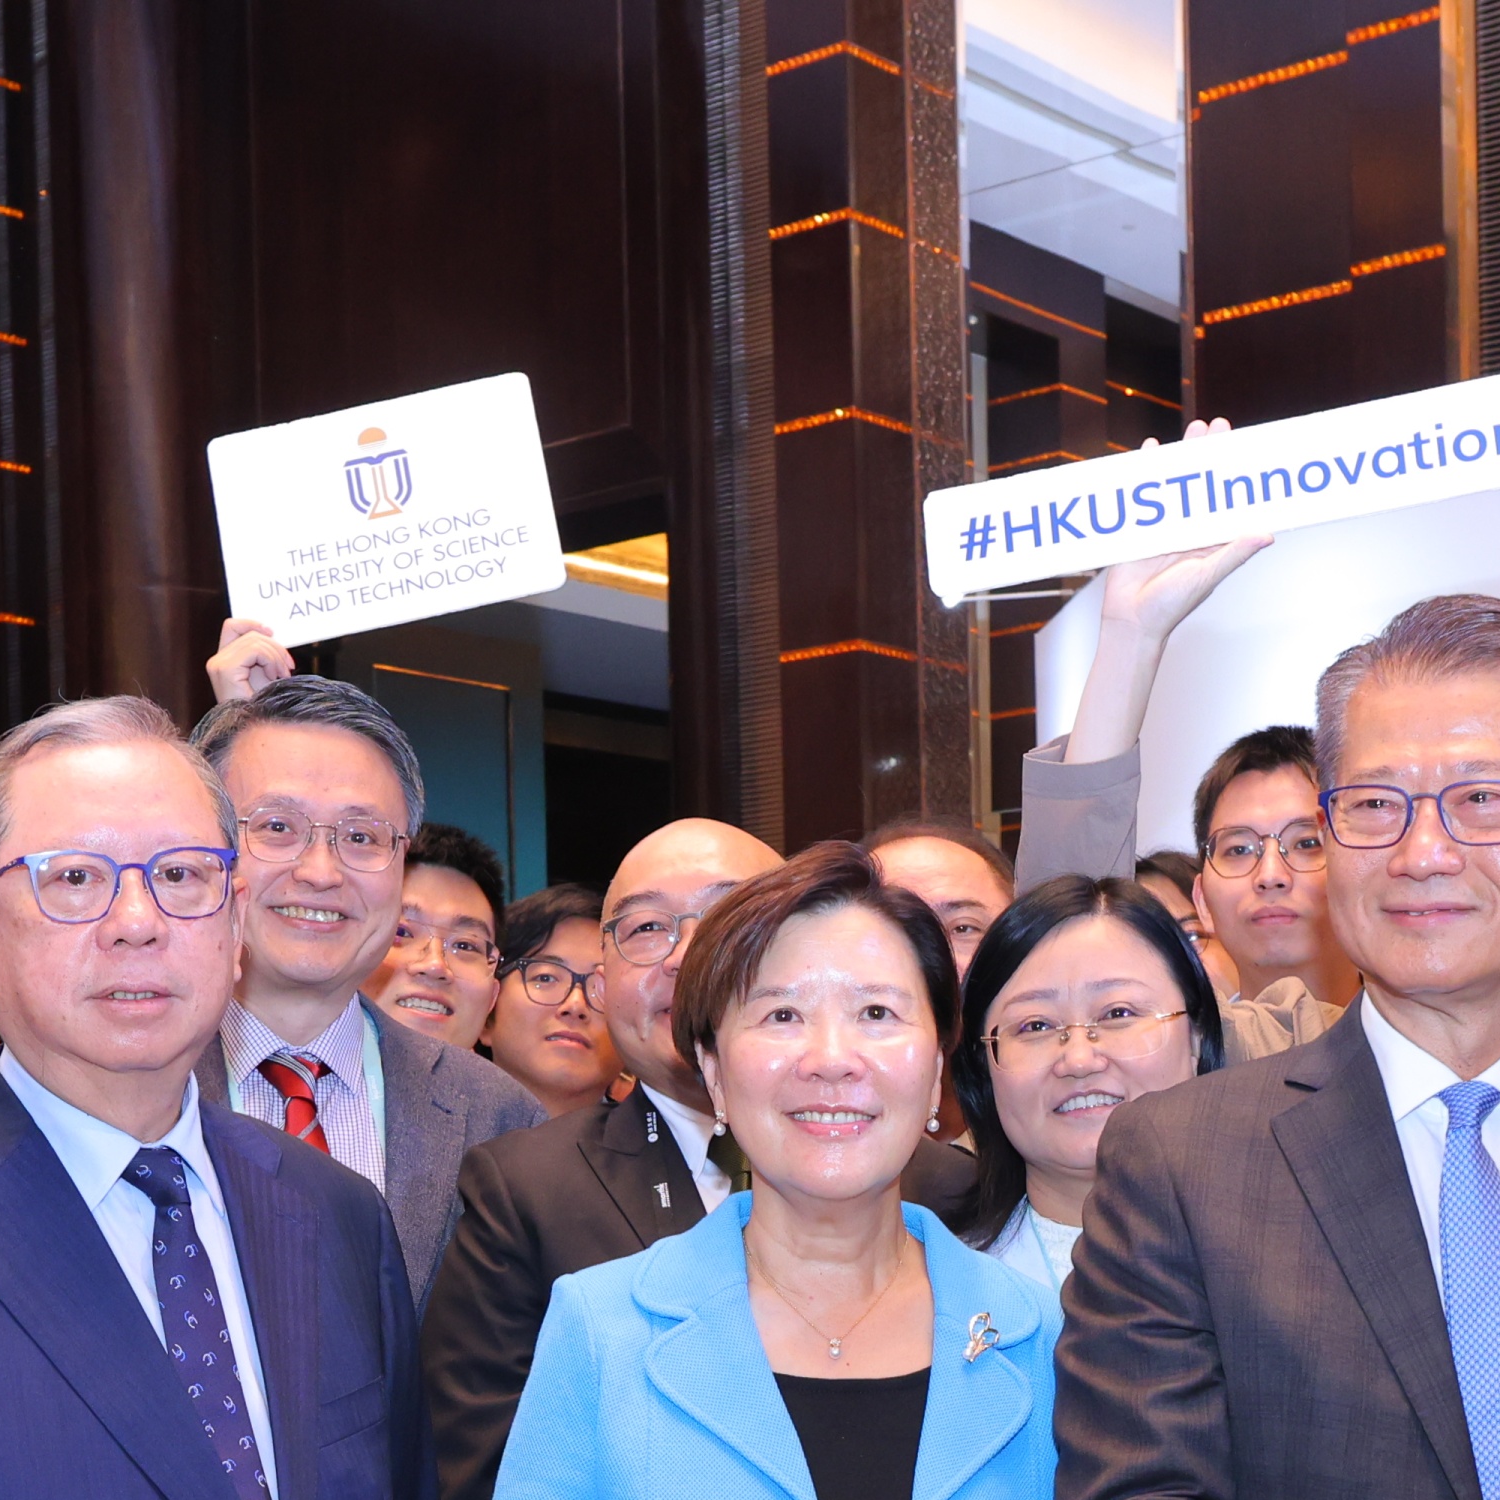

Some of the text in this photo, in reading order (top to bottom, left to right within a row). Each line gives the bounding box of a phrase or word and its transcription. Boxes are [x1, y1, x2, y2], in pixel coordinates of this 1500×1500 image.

[257, 525, 531, 600] UNIVERSITY OF SCIENCE
[286, 508, 492, 568] THE HONG KONG
[288, 556, 509, 620] AND TECHNOLOGY
